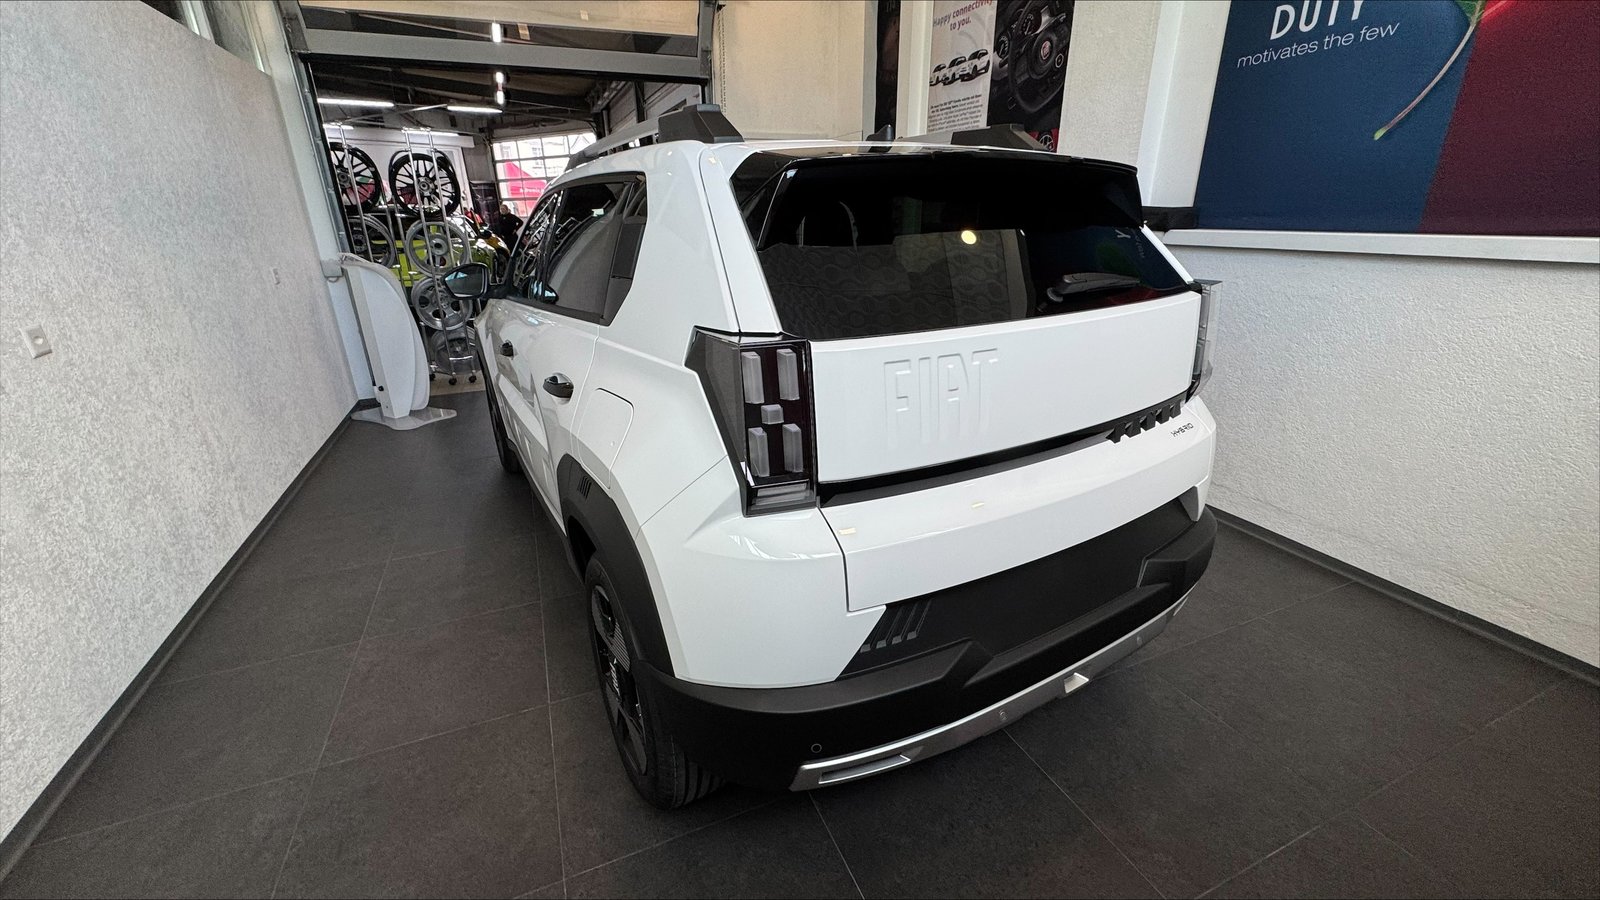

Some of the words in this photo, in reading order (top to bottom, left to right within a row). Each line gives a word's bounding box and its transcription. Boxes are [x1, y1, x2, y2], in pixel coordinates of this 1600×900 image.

[933, 13, 951, 27] Happy
[949, 22, 957, 31] to
[957, 17, 972, 30] you.
[1237, 40, 1319, 68] motivates
[1323, 33, 1354, 50] the
[1359, 22, 1400, 42] few
[883, 347, 999, 446] FIAT
[1170, 422, 1194, 437] HYBRID
